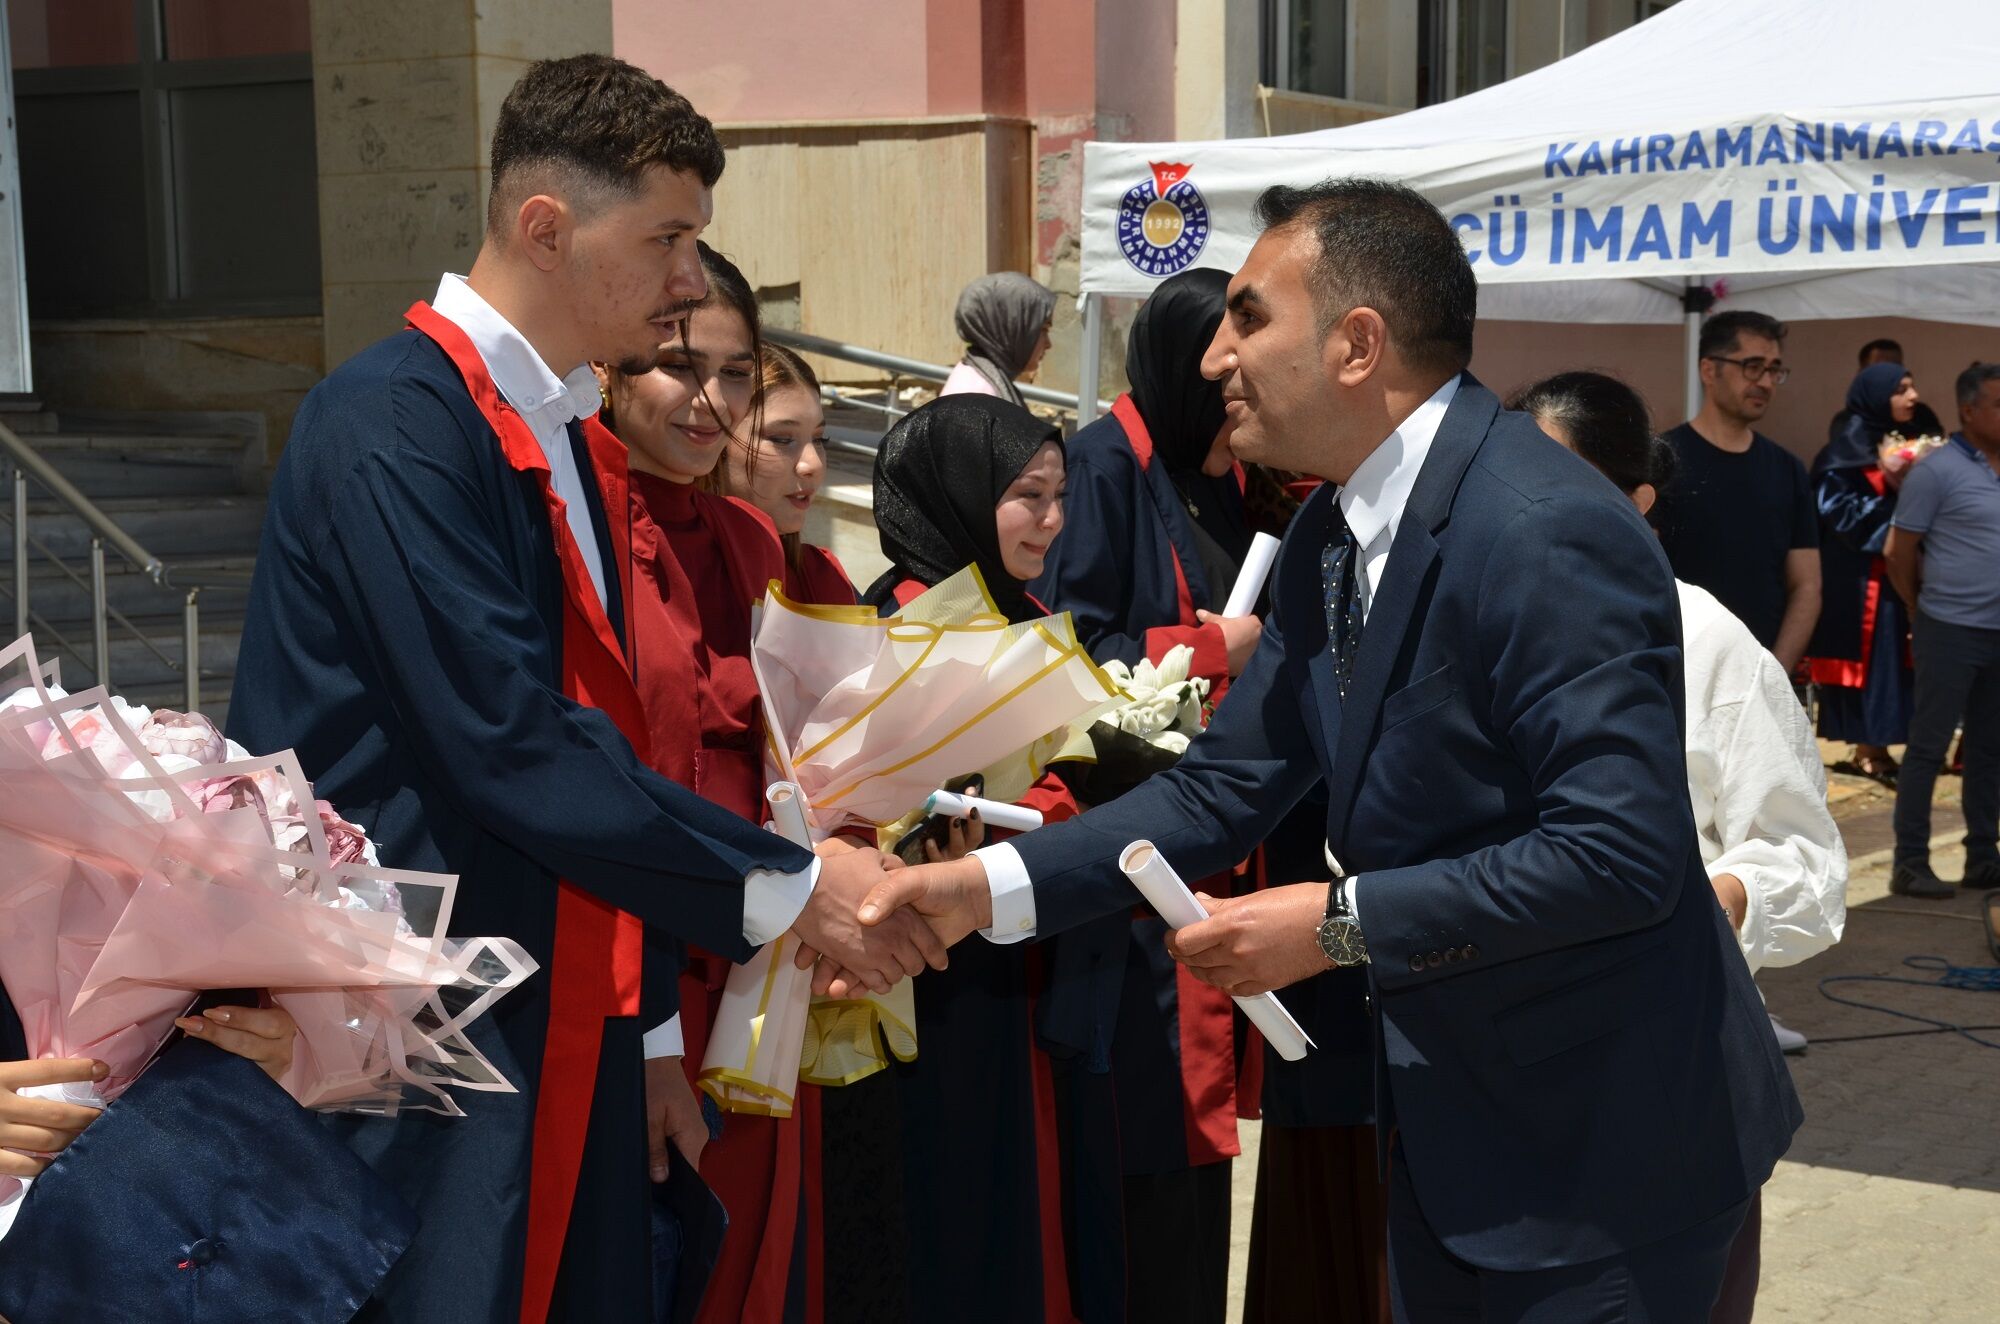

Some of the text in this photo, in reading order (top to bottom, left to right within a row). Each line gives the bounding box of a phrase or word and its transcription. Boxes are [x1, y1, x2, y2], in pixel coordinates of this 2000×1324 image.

[1147, 218, 1180, 229] 1992
[1549, 192, 1733, 264] İMAM
[1757, 173, 2000, 256] ÜNİVE
